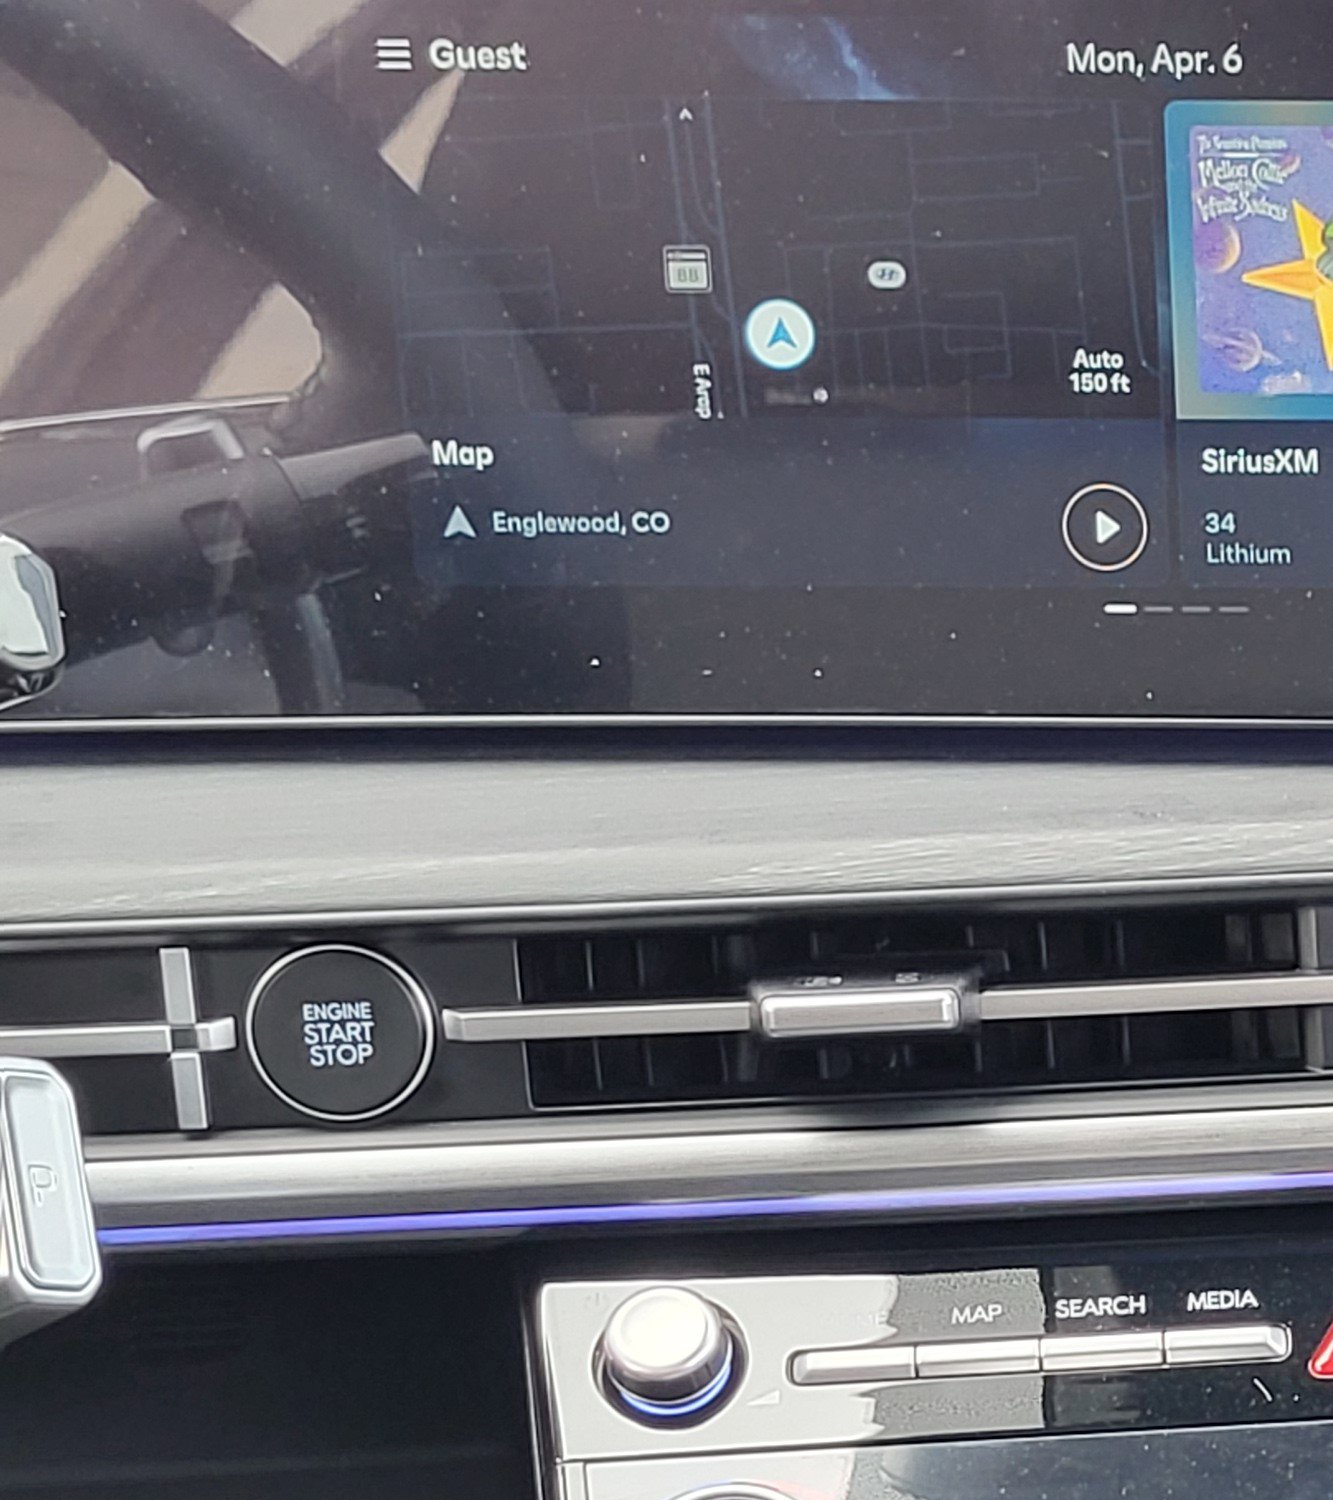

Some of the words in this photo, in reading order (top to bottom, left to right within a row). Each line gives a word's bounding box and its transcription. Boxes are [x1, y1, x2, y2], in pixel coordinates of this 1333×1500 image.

[429, 38, 527, 70] Guest
[1066, 42, 1144, 78] Mon,
[1151, 43, 1215, 80] Apr.
[1223, 44, 1243, 74] 6
[1072, 348, 1124, 369] Auto
[1069, 373, 1108, 393] 150
[1110, 372, 1131, 393] ft
[431, 440, 495, 472] Map
[1202, 448, 1319, 474] SiriusXM
[492, 511, 626, 538] Englewood,
[631, 511, 670, 534] CO
[1205, 512, 1236, 534] 34
[1206, 543, 1292, 564] Lithium
[302, 1002, 373, 1021] ENGINE
[303, 1021, 375, 1045] START
[309, 1044, 374, 1067] STOP
[1055, 1294, 1147, 1318] SEARCH
[1186, 1289, 1260, 1311] MEDIA
[950, 1303, 1003, 1324] MAP
